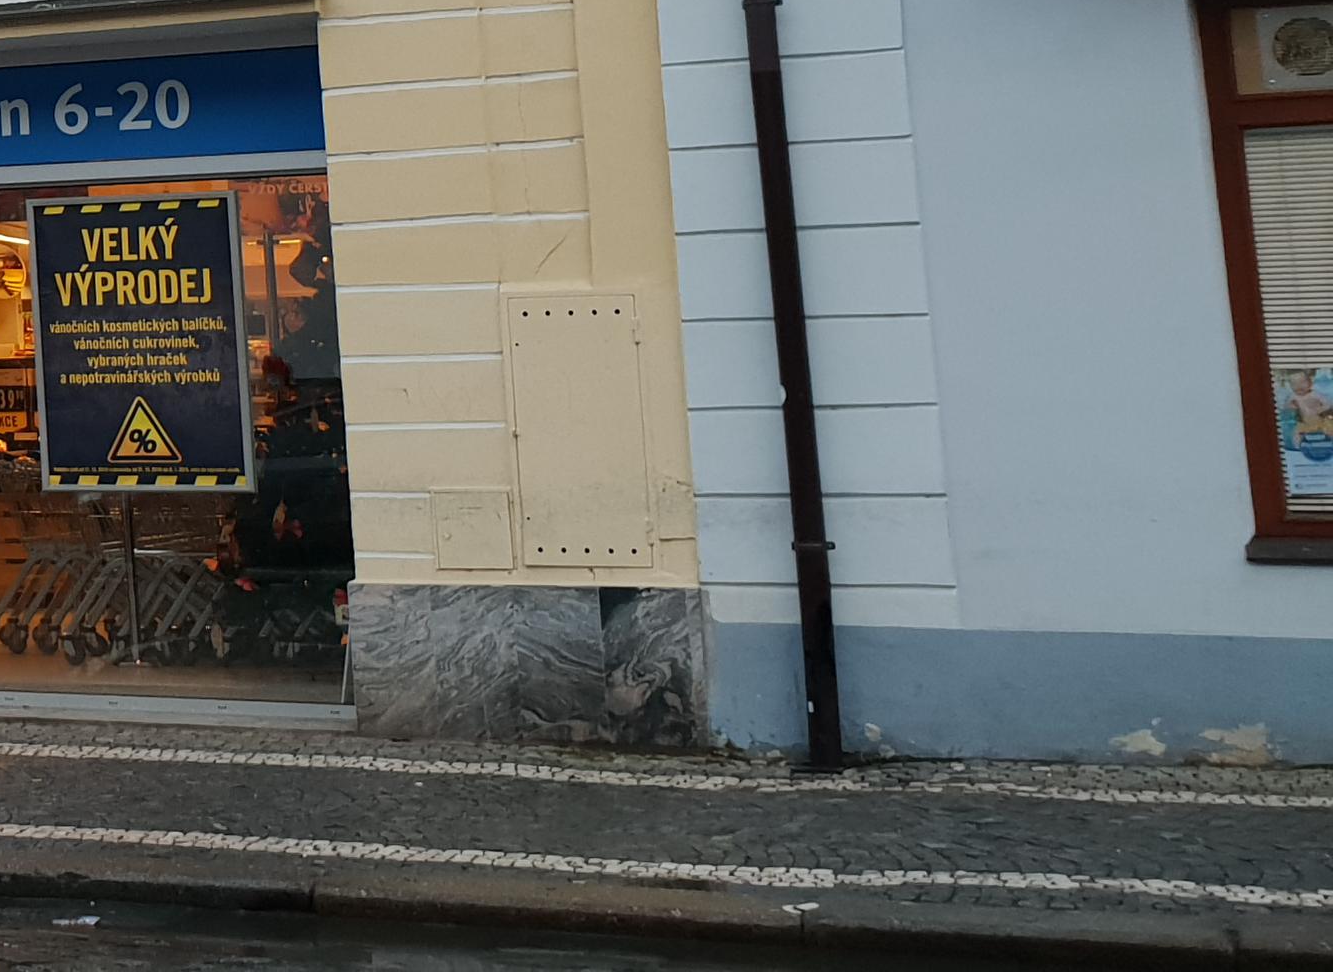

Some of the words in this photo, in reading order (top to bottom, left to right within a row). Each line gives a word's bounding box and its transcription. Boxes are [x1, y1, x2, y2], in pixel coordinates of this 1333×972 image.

[53, 78, 191, 136] 6-20
[81, 217, 179, 263] VELKÝ
[54, 263, 212, 307] VÝPRODEJ
[49, 319, 100, 334] vánočních
[102, 317, 180, 334] kosmetických
[73, 336, 130, 350] vánočních
[132, 335, 200, 350] cukrovinek,
[87, 353, 144, 369] vybraných
[146, 352, 188, 366] hraček
[60, 374, 67, 384] a
[68, 369, 172, 386] nepotravinářských
[174, 368, 221, 385] výrobků
[129, 428, 157, 454] %
